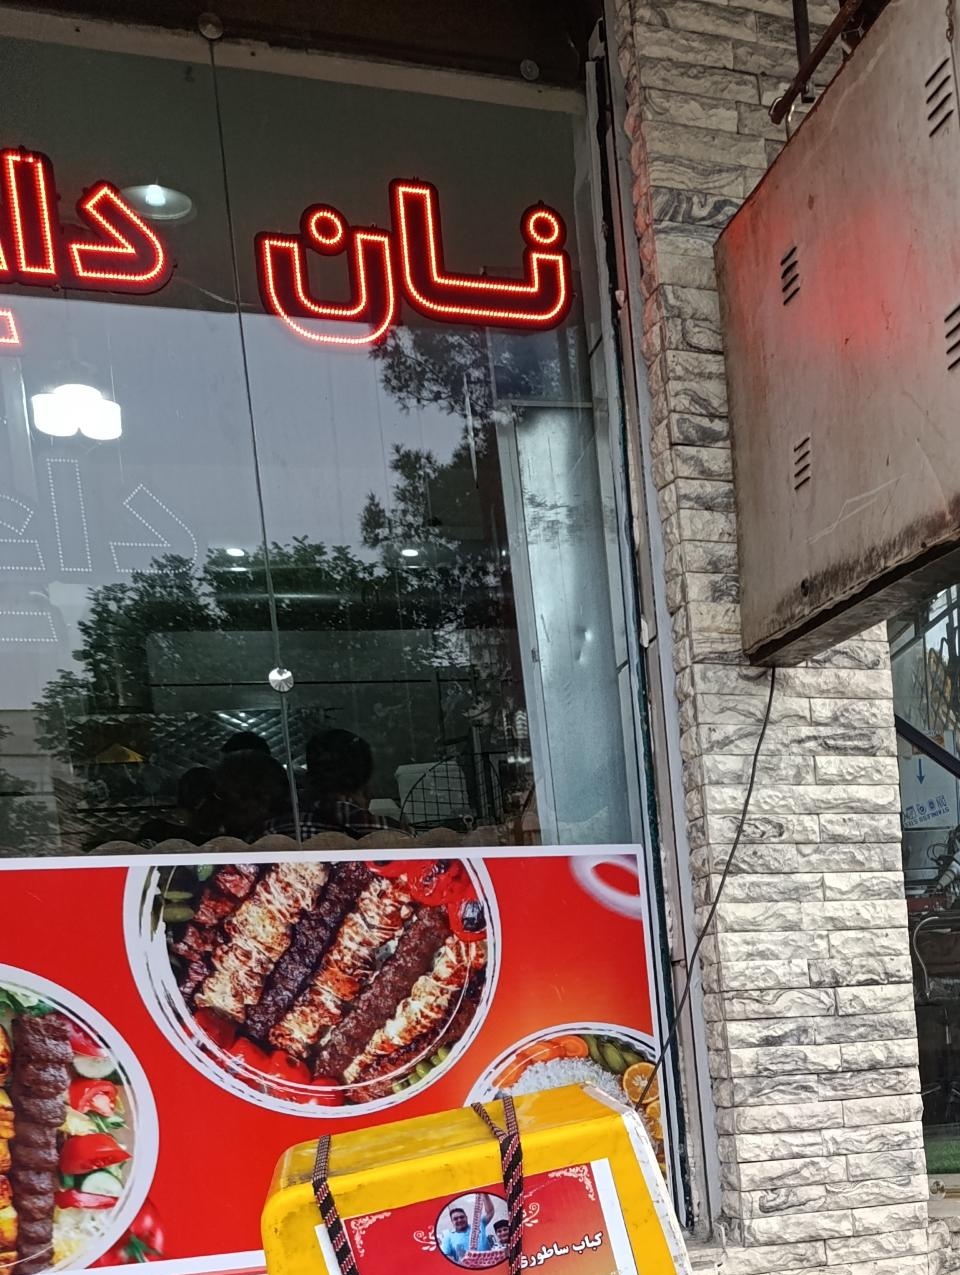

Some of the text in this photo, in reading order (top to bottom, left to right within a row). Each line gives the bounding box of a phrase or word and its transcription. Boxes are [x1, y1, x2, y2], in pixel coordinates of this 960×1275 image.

[257, 179, 571, 347] نان
[520, 1231, 604, 1269] کباب ساطوری
